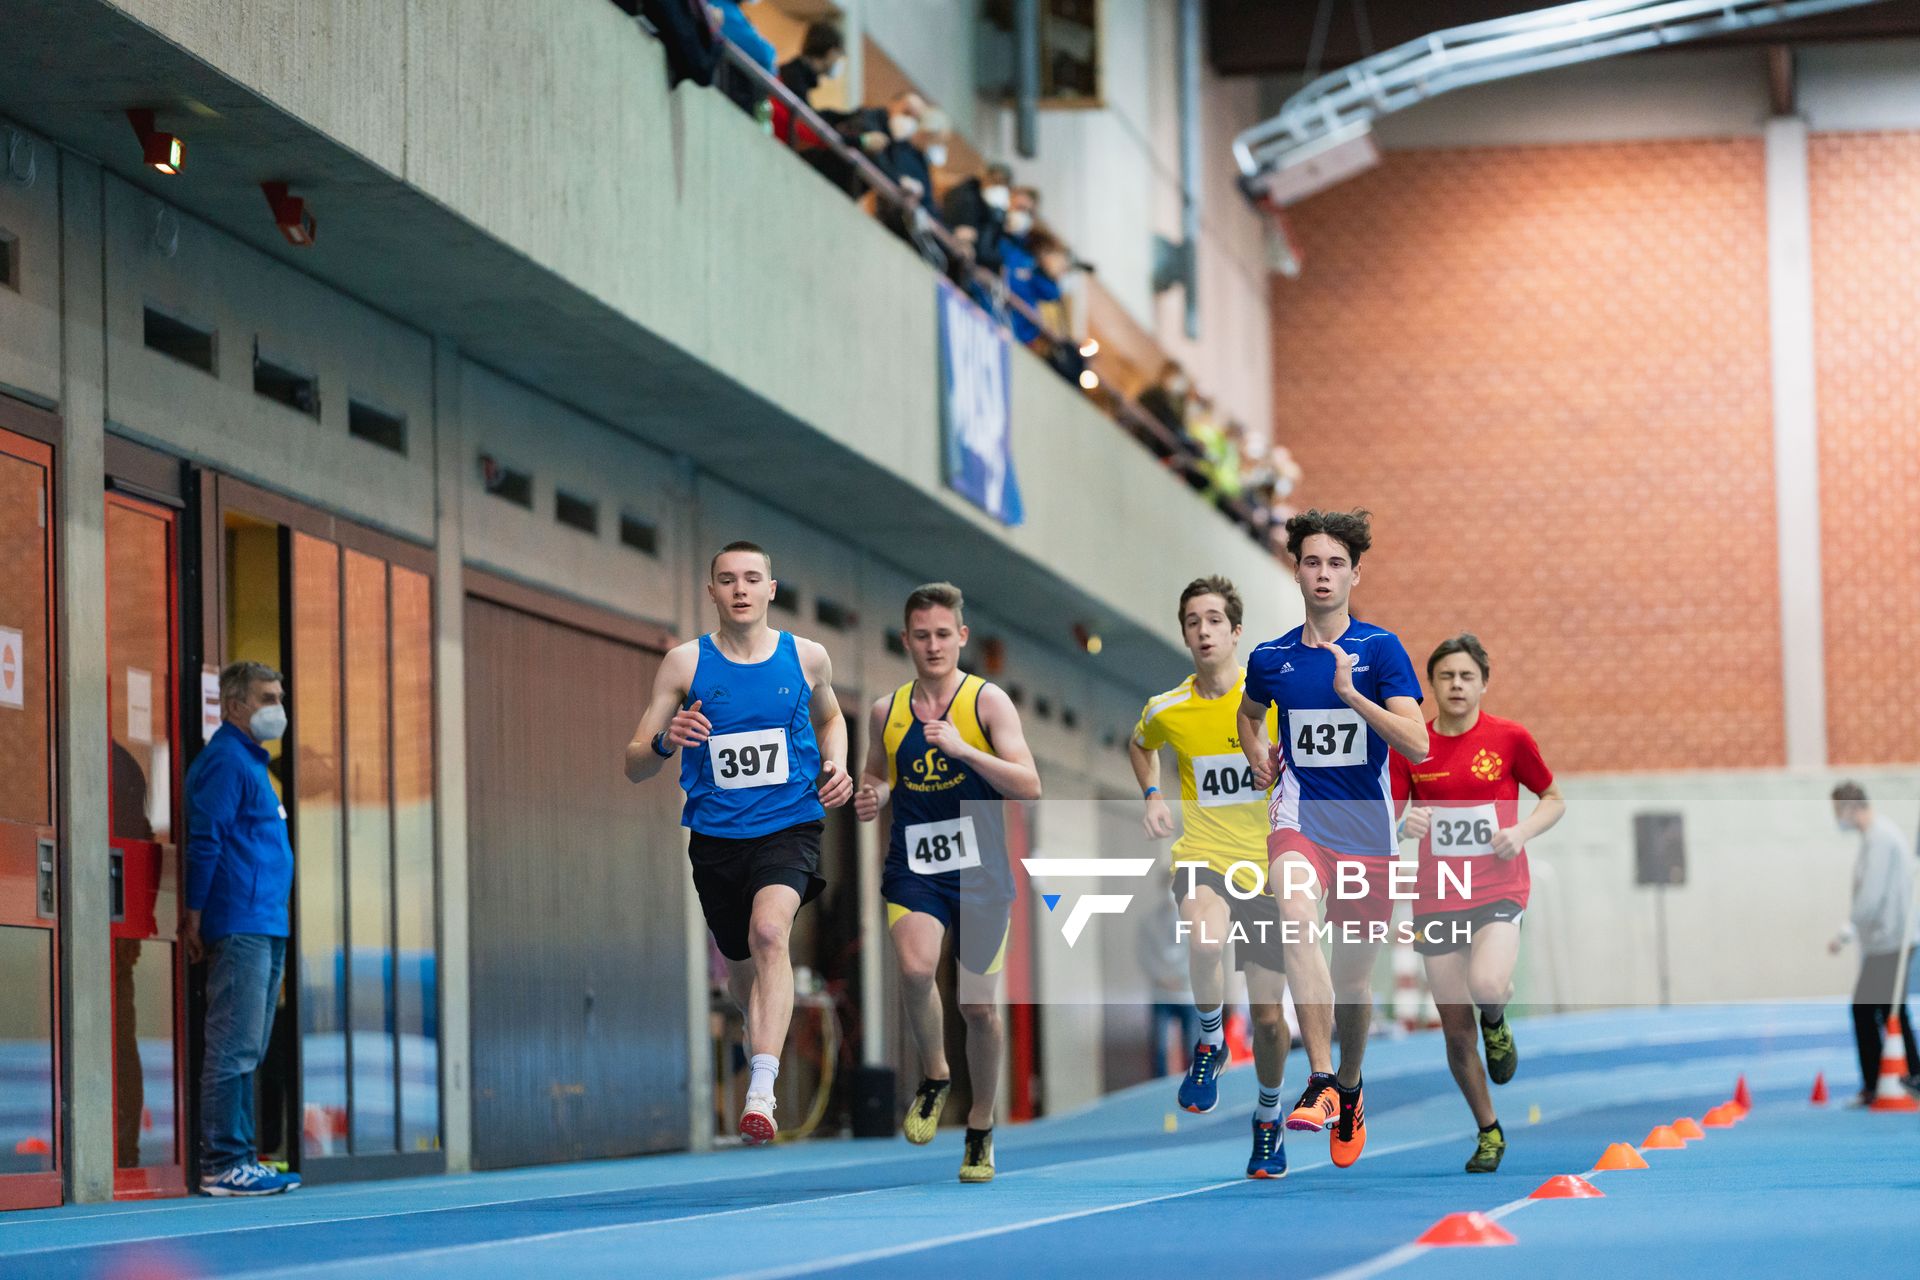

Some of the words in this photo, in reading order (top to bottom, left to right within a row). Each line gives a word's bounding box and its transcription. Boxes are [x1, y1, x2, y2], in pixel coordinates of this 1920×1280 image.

[1296, 723, 1358, 755] 437
[718, 743, 780, 780] 397
[1202, 767, 1257, 796] 404
[915, 831, 967, 864] 481
[1436, 818, 1492, 846] 326
